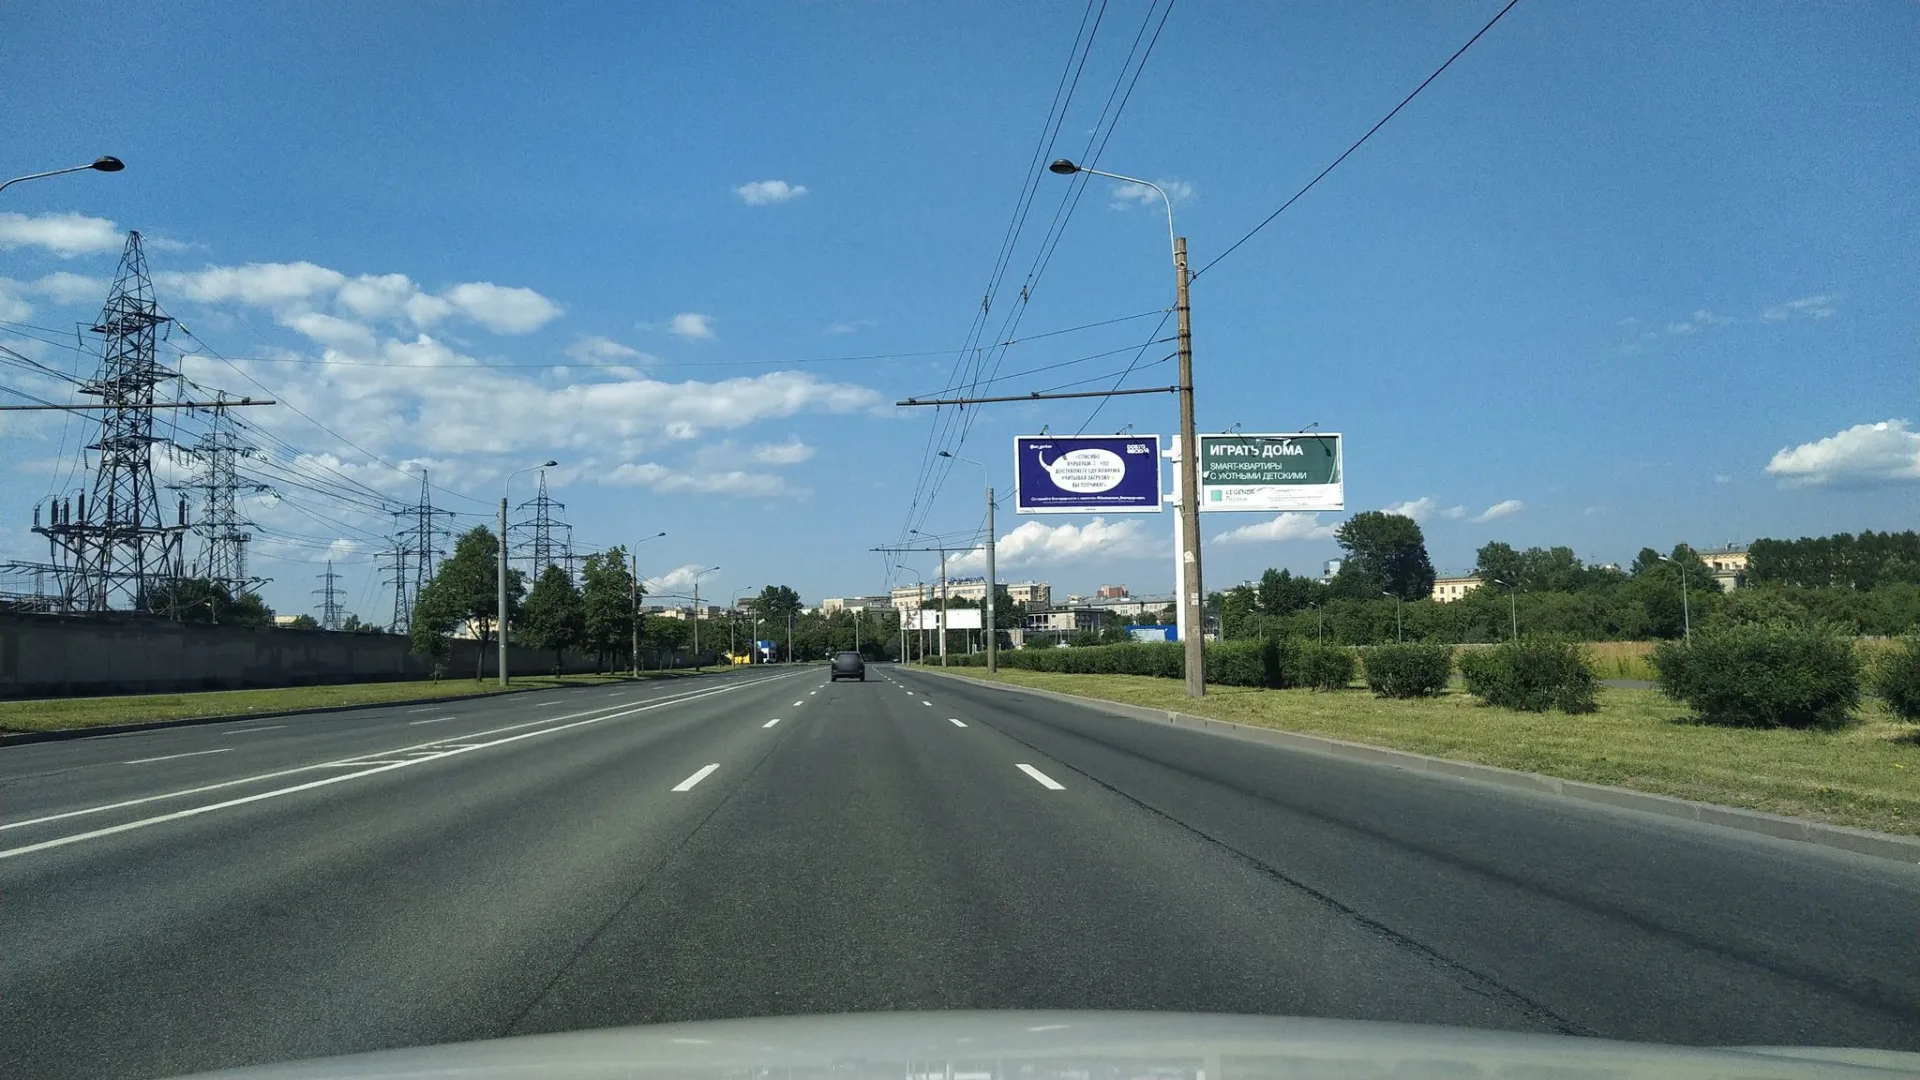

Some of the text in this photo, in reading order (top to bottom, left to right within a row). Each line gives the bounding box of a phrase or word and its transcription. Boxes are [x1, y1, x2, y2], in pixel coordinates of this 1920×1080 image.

[1210, 444, 1304, 458] ИГРАТЬ ДОМА
[1210, 462, 1282, 470] SMART-КВАРТИРЫ
[1210, 472, 1308, 481] С УЮТНЫМИ ДЕТСКИМИ
